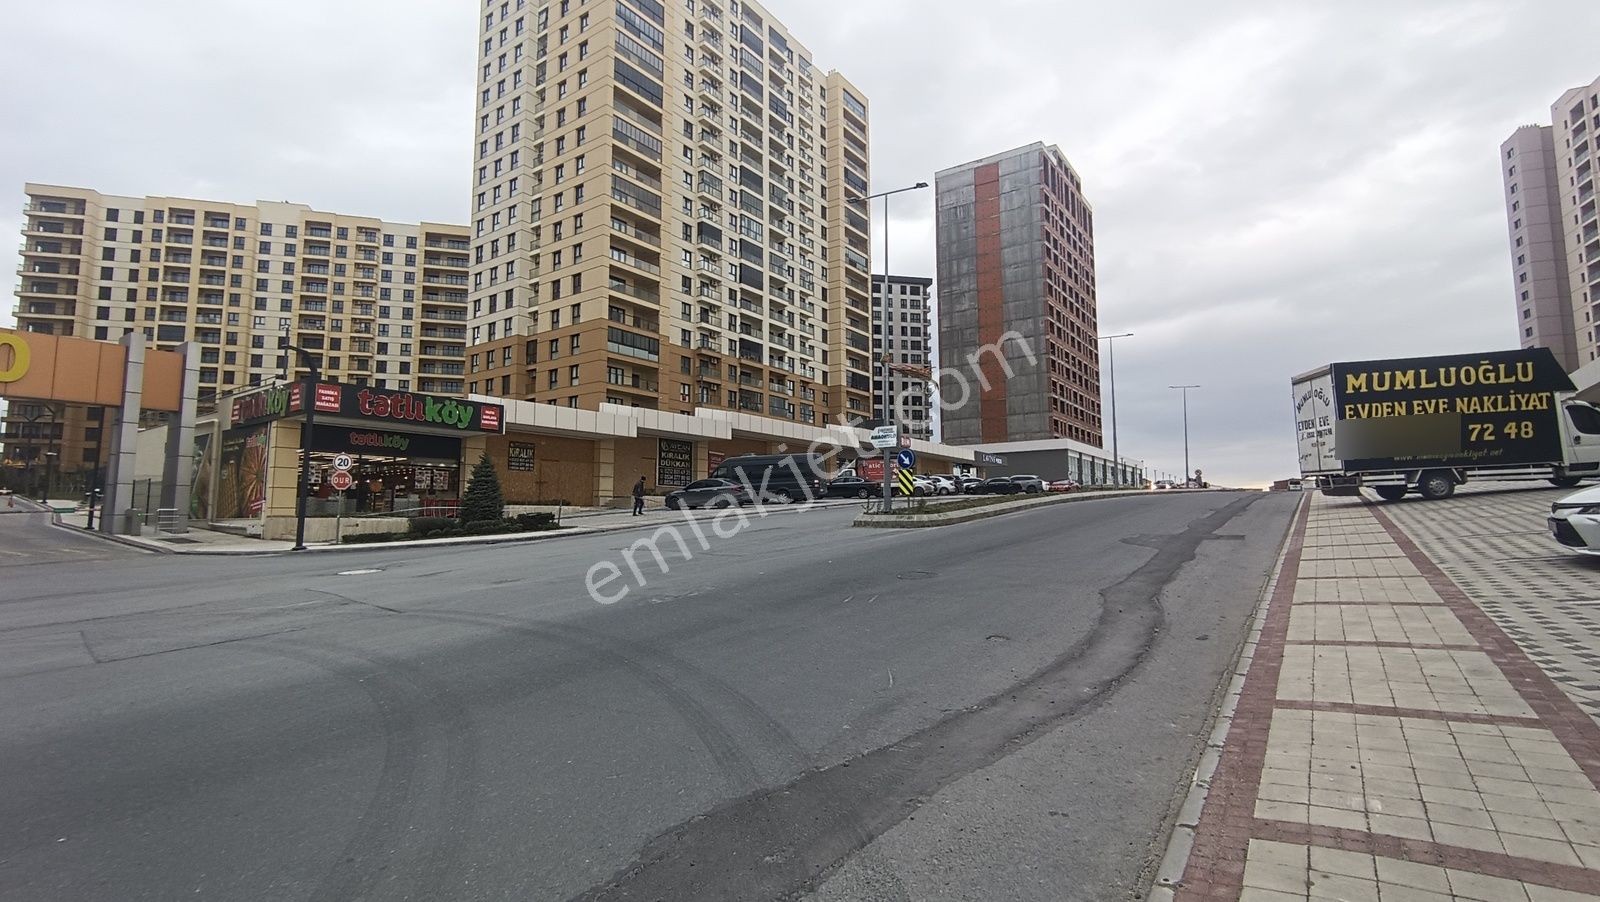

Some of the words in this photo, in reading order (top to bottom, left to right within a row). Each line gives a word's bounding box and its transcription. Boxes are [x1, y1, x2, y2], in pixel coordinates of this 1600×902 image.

[1345, 360, 1534, 394] MUMLUOĞLU
[1345, 400, 1407, 420] EVDEN
[1413, 398, 1449, 415] EVE
[1455, 389, 1551, 414] NAKLİYAT
[1318, 415, 1330, 427] EVE
[1468, 423, 1496, 442] 72
[1504, 420, 1534, 439] 48
[337, 457, 349, 467] 20
